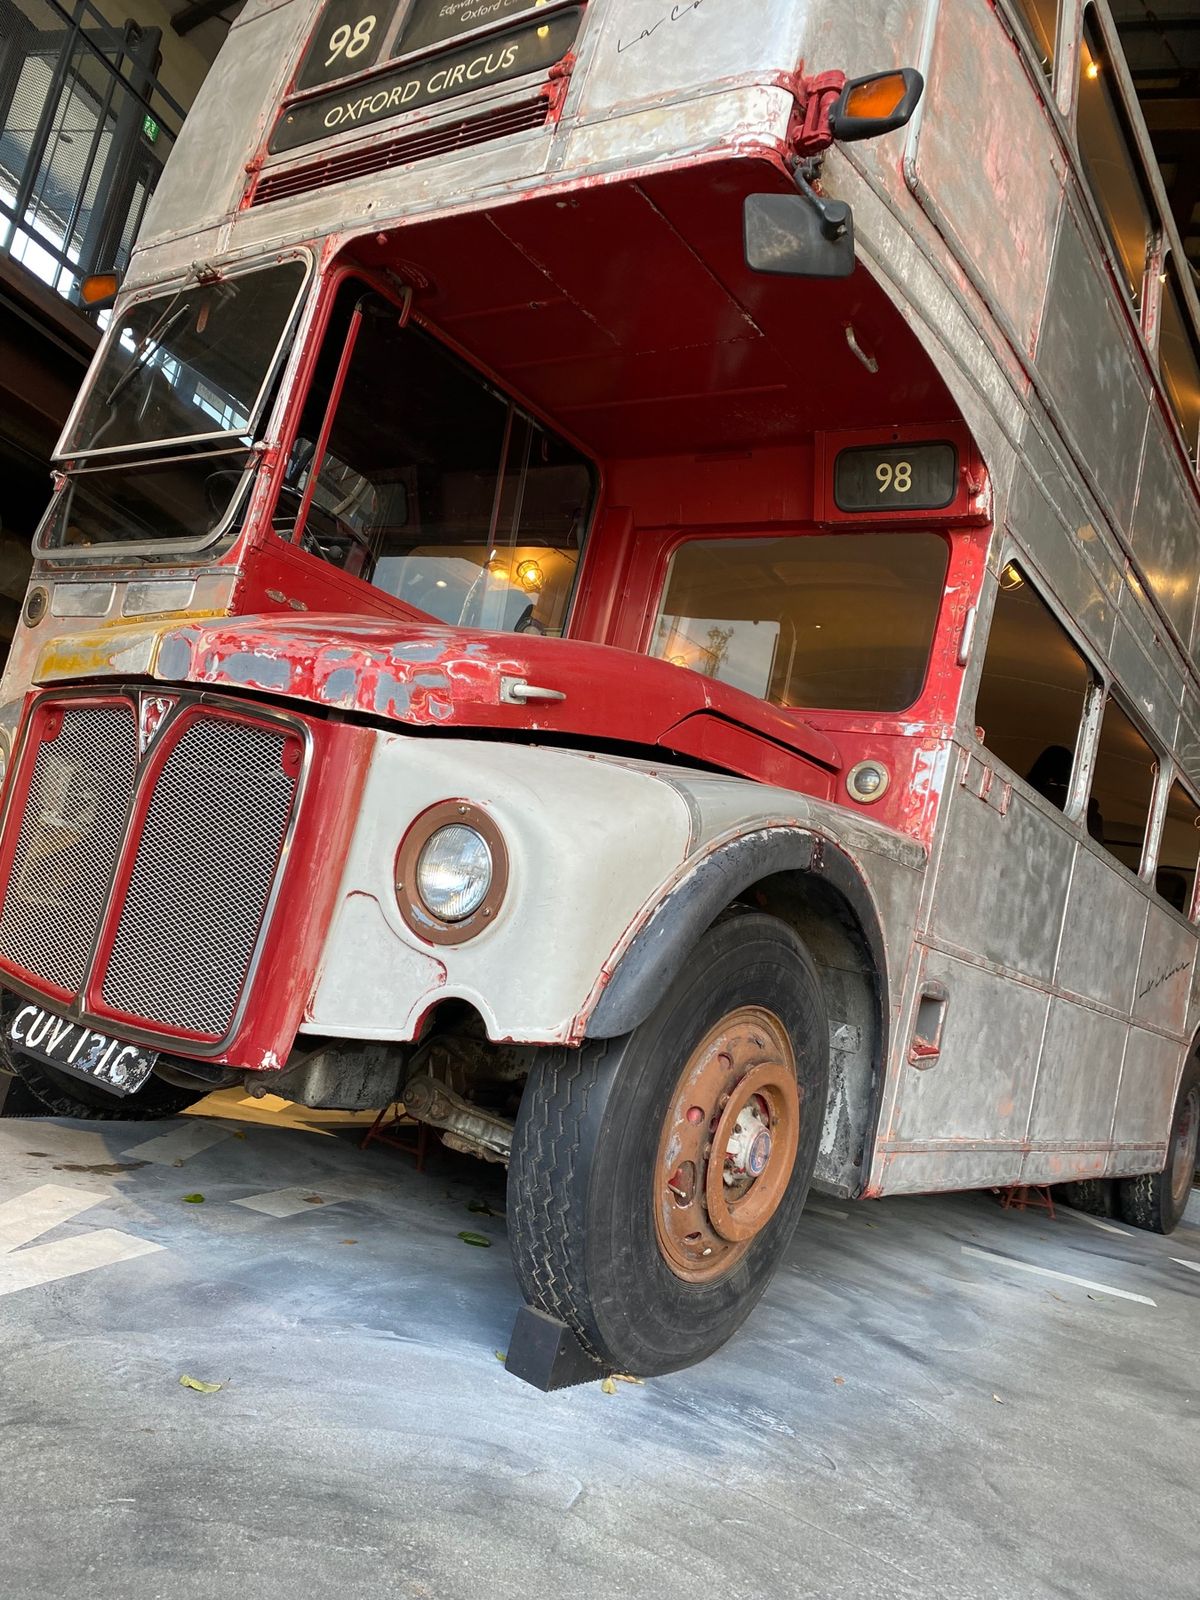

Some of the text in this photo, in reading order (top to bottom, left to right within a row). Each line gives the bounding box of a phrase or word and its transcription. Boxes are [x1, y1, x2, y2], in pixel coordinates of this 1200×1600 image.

[439, 0, 480, 17] Edgwar
[461, 0, 501, 21] Oxford
[325, 15, 377, 67] 98
[324, 45, 519, 128] OXFORD CIRCUS
[875, 461, 912, 493] 98
[10, 1005, 75, 1056] CUV
